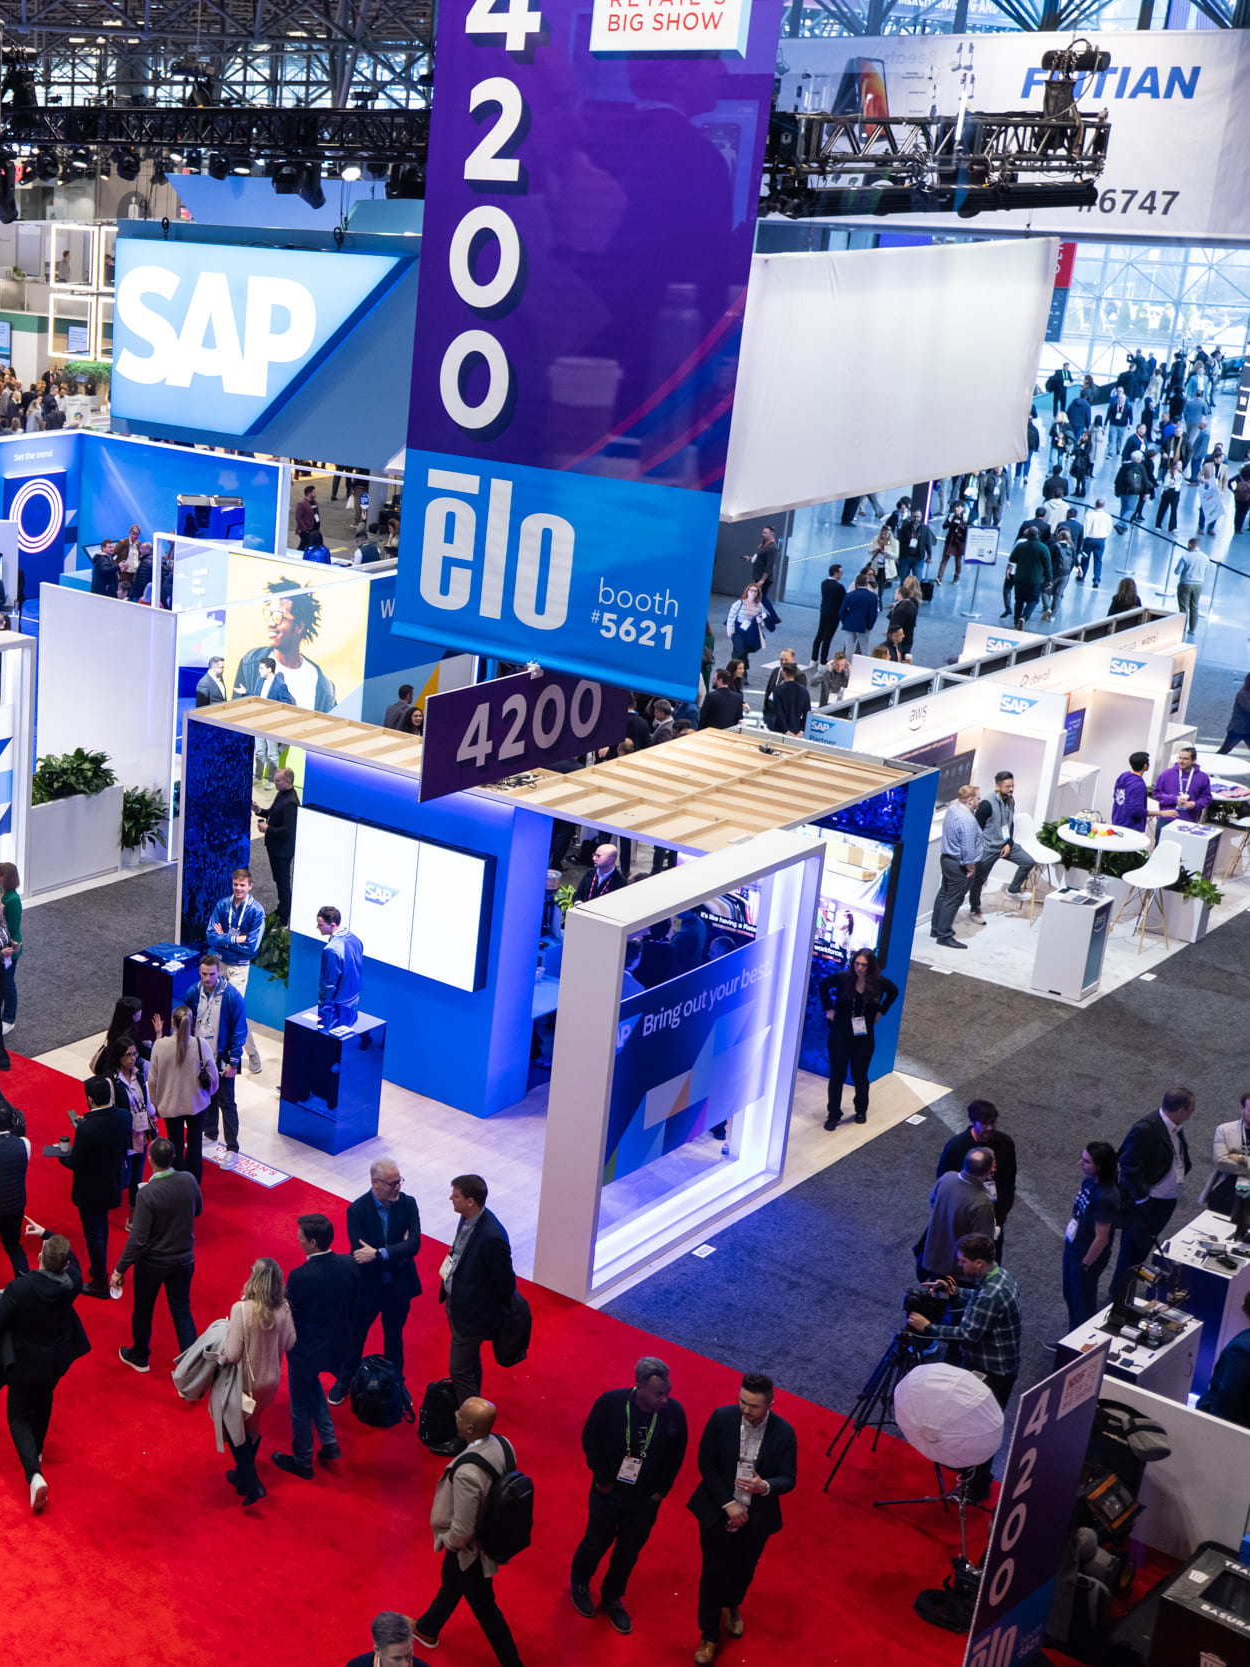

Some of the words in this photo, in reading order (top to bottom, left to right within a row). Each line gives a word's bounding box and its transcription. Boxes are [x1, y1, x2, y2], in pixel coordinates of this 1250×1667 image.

[608, 14, 644, 32] BIG
[652, 12, 724, 31] SHOW
[114, 265, 316, 398] SAP
[598, 577, 679, 618] booth
[590, 609, 674, 650] #5621
[986, 638, 1013, 651] SAP
[1110, 659, 1138, 675] SAP
[872, 671, 899, 685] SAP
[1000, 695, 1030, 713] SAP
[910, 705, 928, 723] aws
[456, 679, 603, 768] 4200
[810, 720, 830, 731] SAP
[809, 734, 837, 746] Partner
[365, 884, 392, 902] SAP
[719, 916, 737, 929] having
[642, 1002, 681, 1037] Bring
[683, 989, 707, 1017] out
[709, 977, 739, 1011] your
[740, 960, 772, 989] best.
[989, 1389, 1050, 1607] 4200
[1225, 1560, 1250, 1576] TRA
